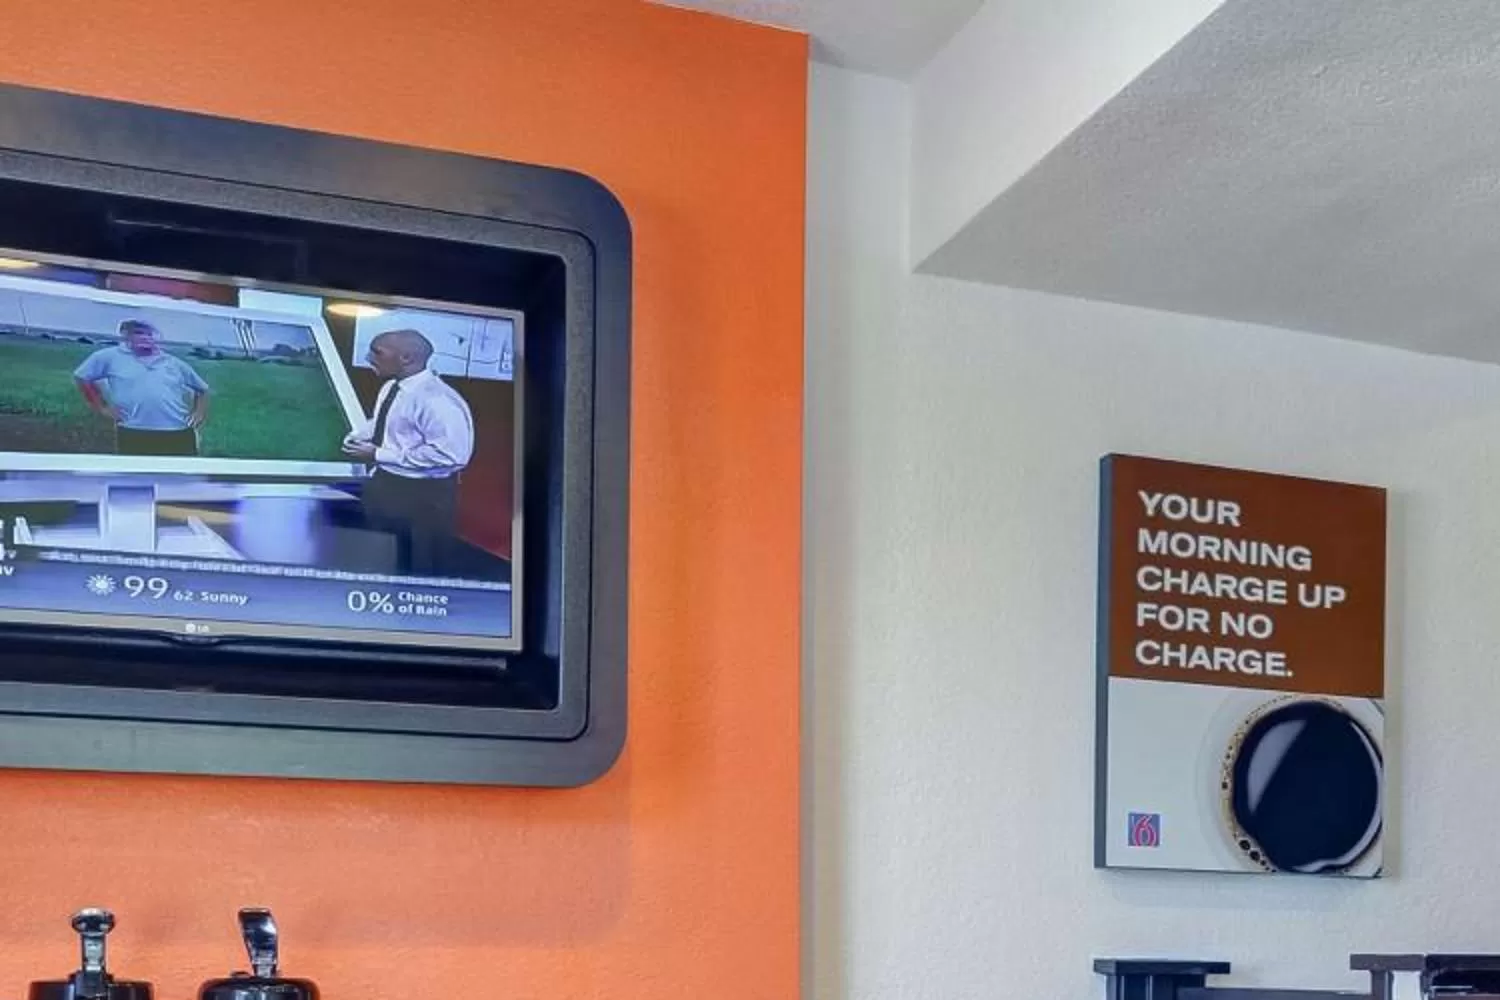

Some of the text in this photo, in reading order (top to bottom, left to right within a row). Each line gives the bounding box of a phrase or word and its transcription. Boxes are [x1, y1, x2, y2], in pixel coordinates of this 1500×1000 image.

[1138, 490, 1241, 527] YOUR
[1137, 528, 1313, 571] MORNING
[123, 575, 169, 600] 99
[200, 591, 249, 606] Sunny
[347, 590, 395, 614] 0%
[397, 591, 449, 605] Chance
[1136, 566, 1346, 609] CHARGE UP
[415, 604, 448, 617] Rain
[1136, 602, 1273, 639] FOR NO
[1135, 640, 1294, 677] CHARGE.
